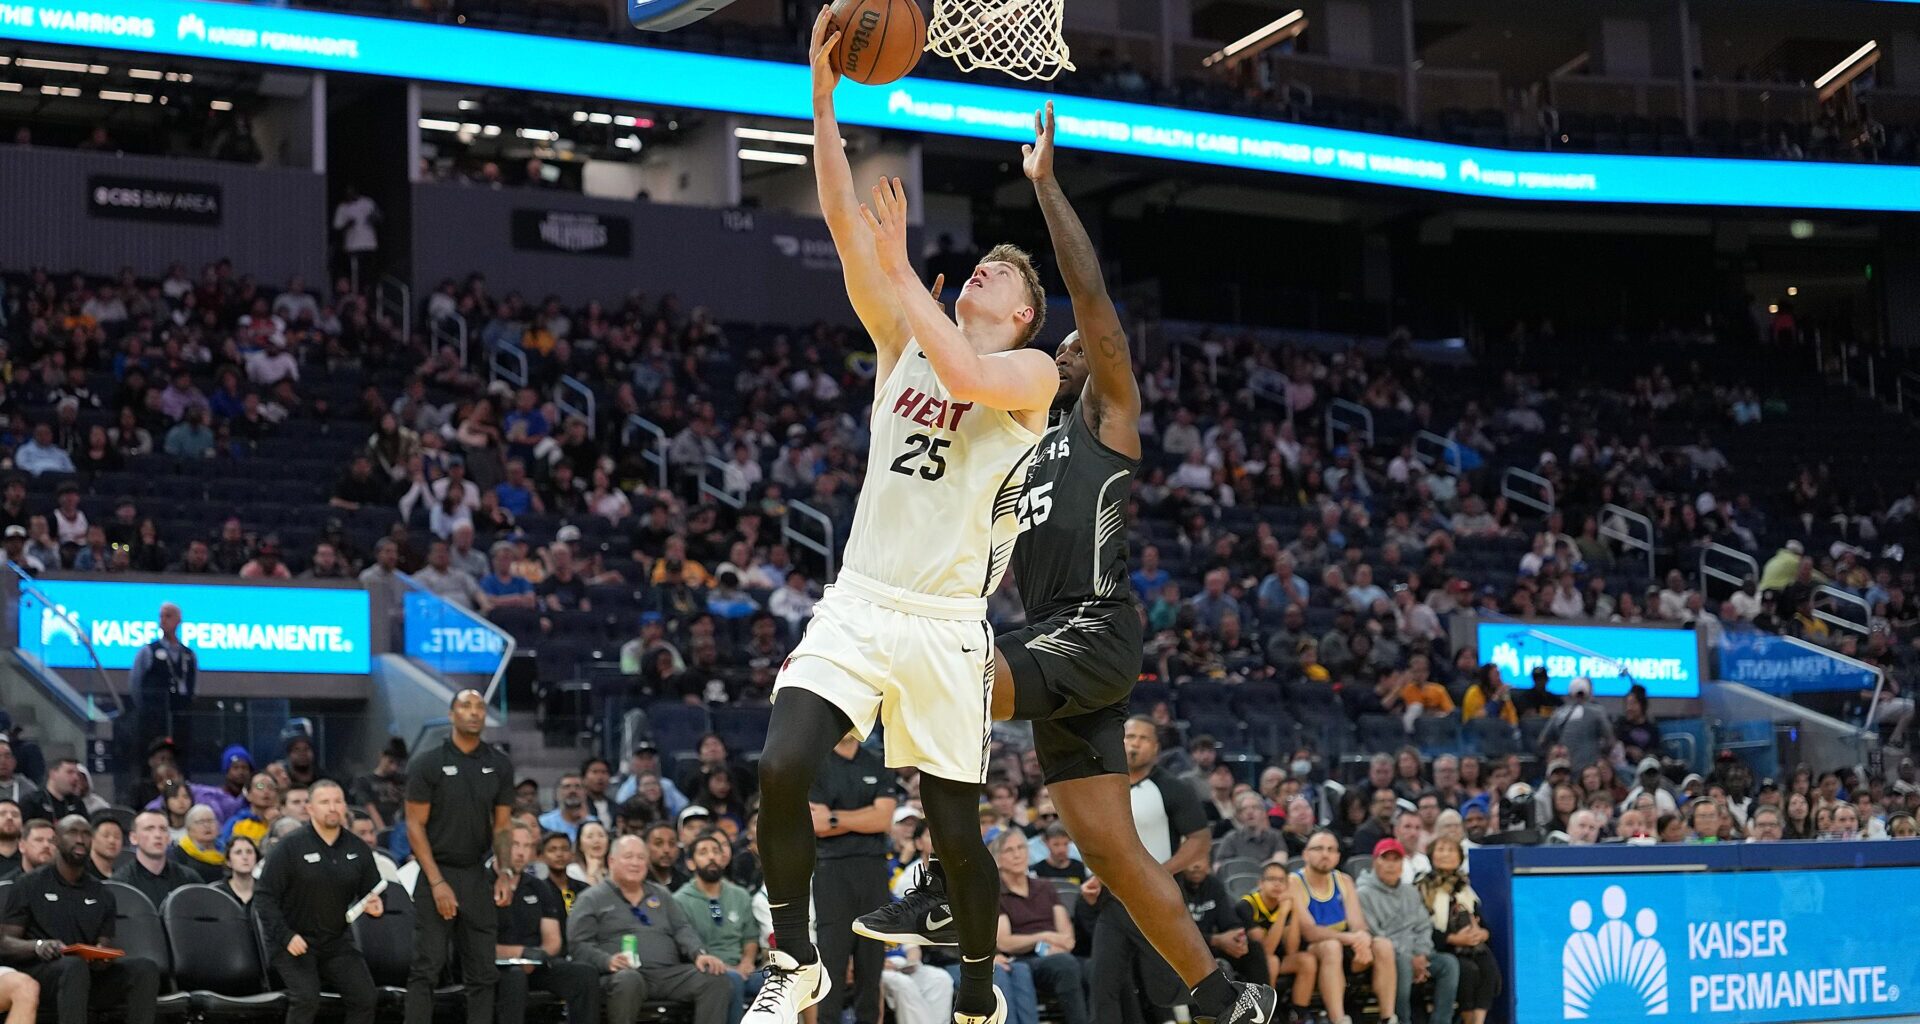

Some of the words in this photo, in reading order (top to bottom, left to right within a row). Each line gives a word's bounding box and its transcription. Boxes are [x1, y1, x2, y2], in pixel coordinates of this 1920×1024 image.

[39, 8, 155, 38] WARRIORS
[845, 10, 881, 72] Wilson
[1131, 124, 1194, 148] HEALTH
[1337, 149, 1366, 171] THE
[108, 187, 141, 207] CBS
[143, 189, 174, 210] BAY
[174, 192, 217, 214] AREA
[893, 387, 973, 431] HEAT
[890, 433, 951, 481] 25
[1017, 481, 1053, 533] 25
[91, 619, 164, 648] KAISE
[1688, 919, 1788, 960] KAISER
